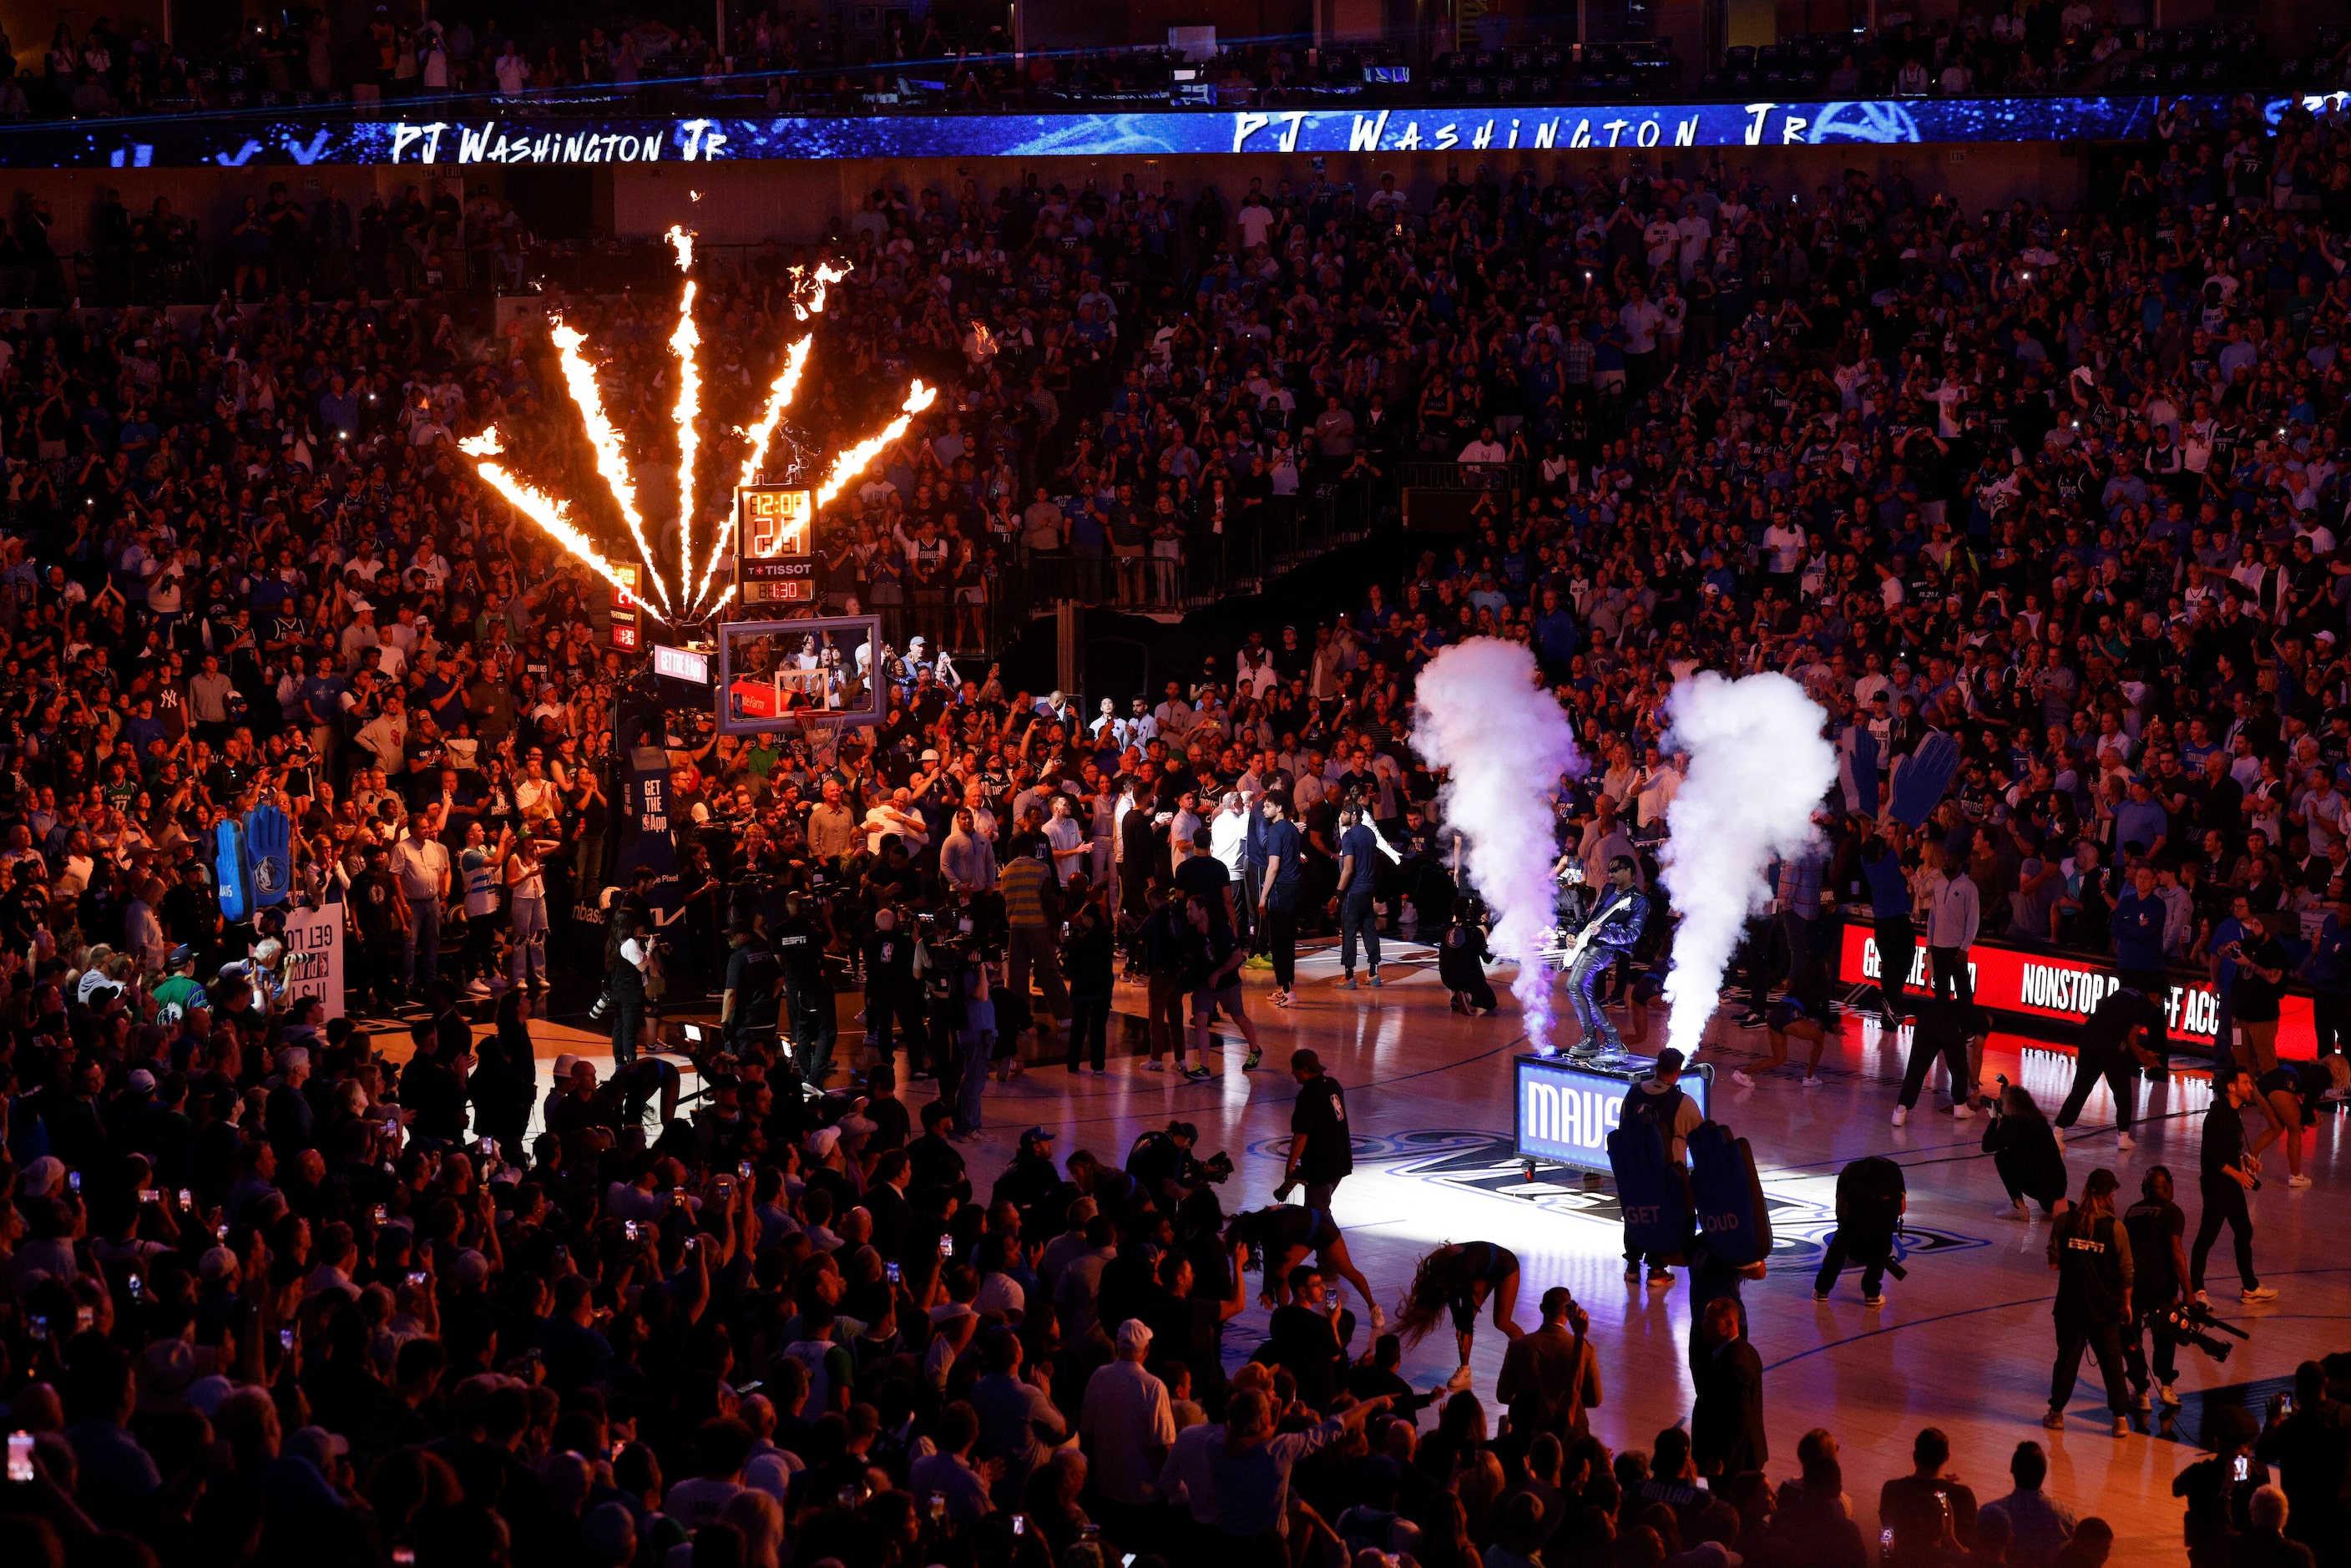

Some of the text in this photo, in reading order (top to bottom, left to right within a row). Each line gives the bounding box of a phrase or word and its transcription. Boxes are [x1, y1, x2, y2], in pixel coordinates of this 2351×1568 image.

[1233, 110, 1309, 153] PJ
[392, 121, 452, 164] PJ
[919, 550, 939, 559] MAVS
[765, 564, 811, 575] TISSOT
[773, 582, 797, 598] 1:30
[528, 664, 547, 672] DALLAS
[160, 689, 178, 709] NY
[644, 780, 661, 796] GET
[115, 800, 126, 812] 77
[645, 797, 662, 812] THE
[650, 815, 667, 833] App
[662, 873, 679, 883] Pixel
[307, 924, 332, 949] GET
[781, 935, 806, 946] ESPN
[747, 950, 772, 964] ESPN
[2020, 962, 2105, 1014] NONSTOP
[1626, 1205, 1661, 1226] GET
[2067, 1237, 2106, 1254] ESPN
